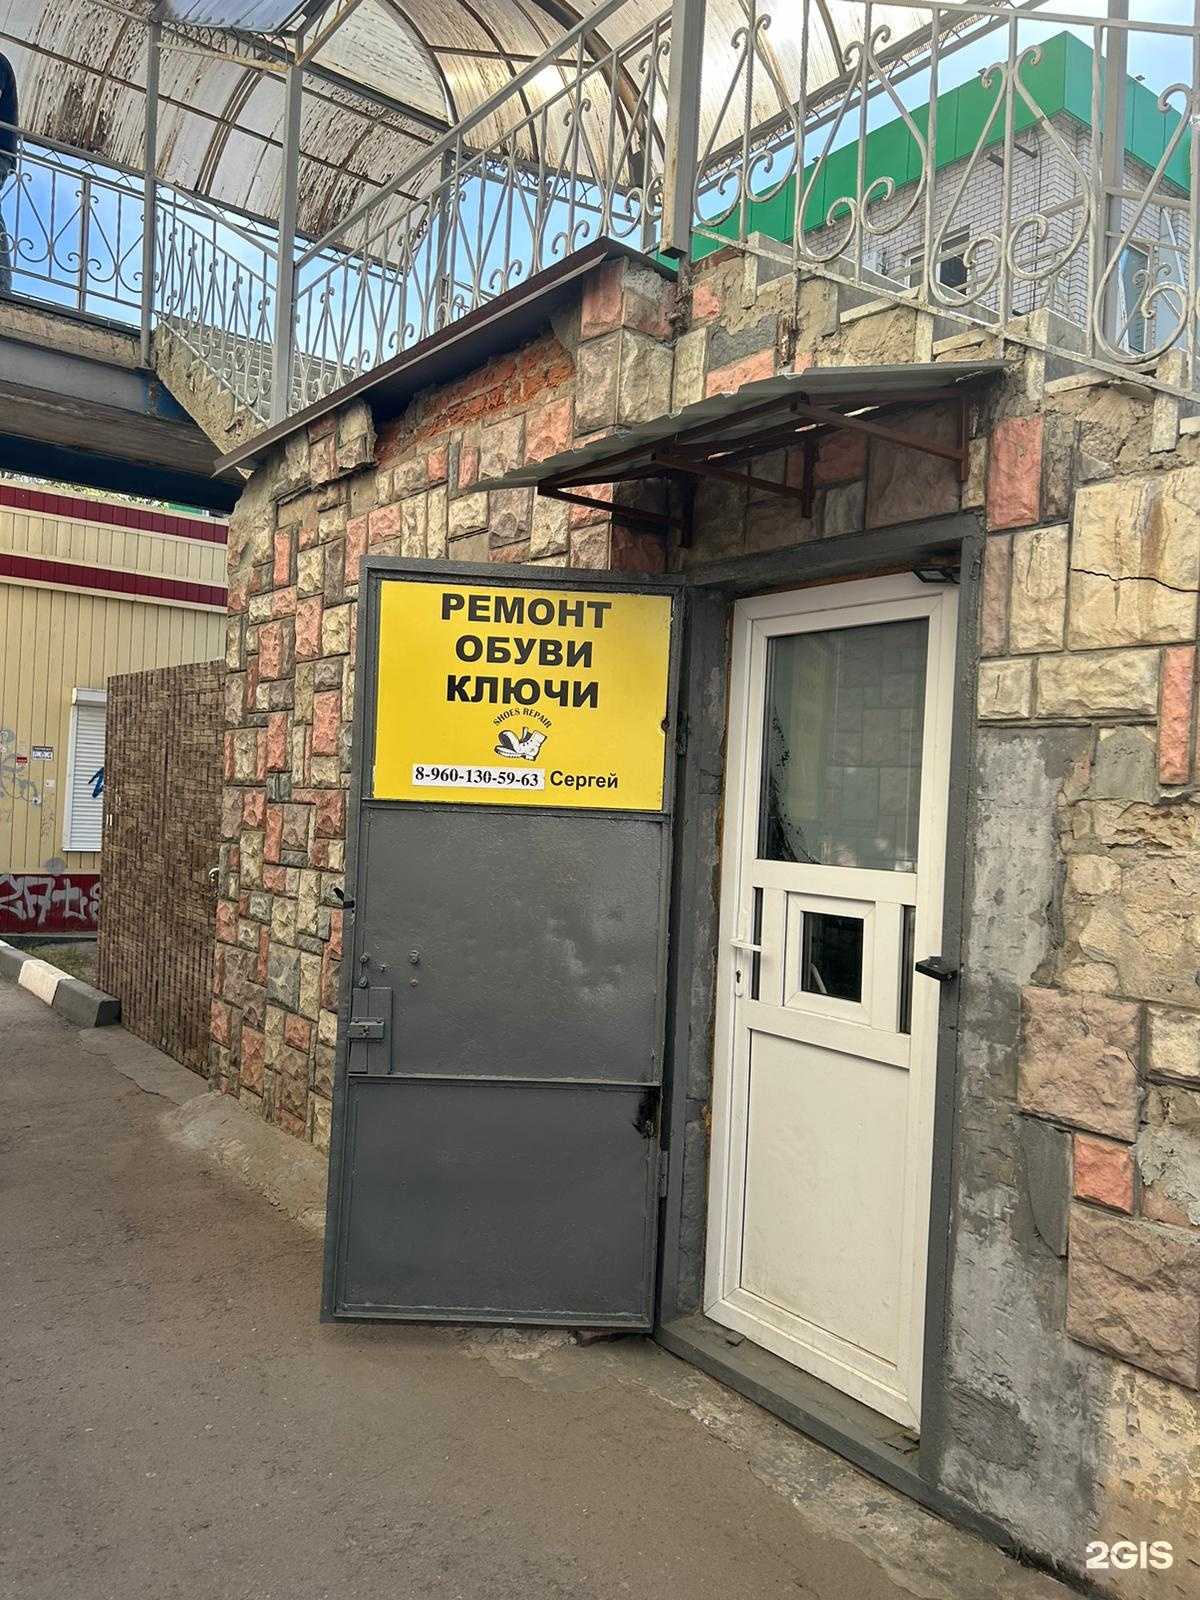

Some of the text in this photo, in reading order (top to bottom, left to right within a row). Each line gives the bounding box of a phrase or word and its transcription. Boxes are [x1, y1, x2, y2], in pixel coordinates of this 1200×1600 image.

[441, 592, 612, 628] РЕМОНТ
[455, 635, 593, 668] ОБУВИ
[446, 674, 599, 708] КЛЮЧИ
[493, 708, 552, 728] SHOES REPAIR
[415, 766, 619, 790] 8-960-130-59-63 Сергей
